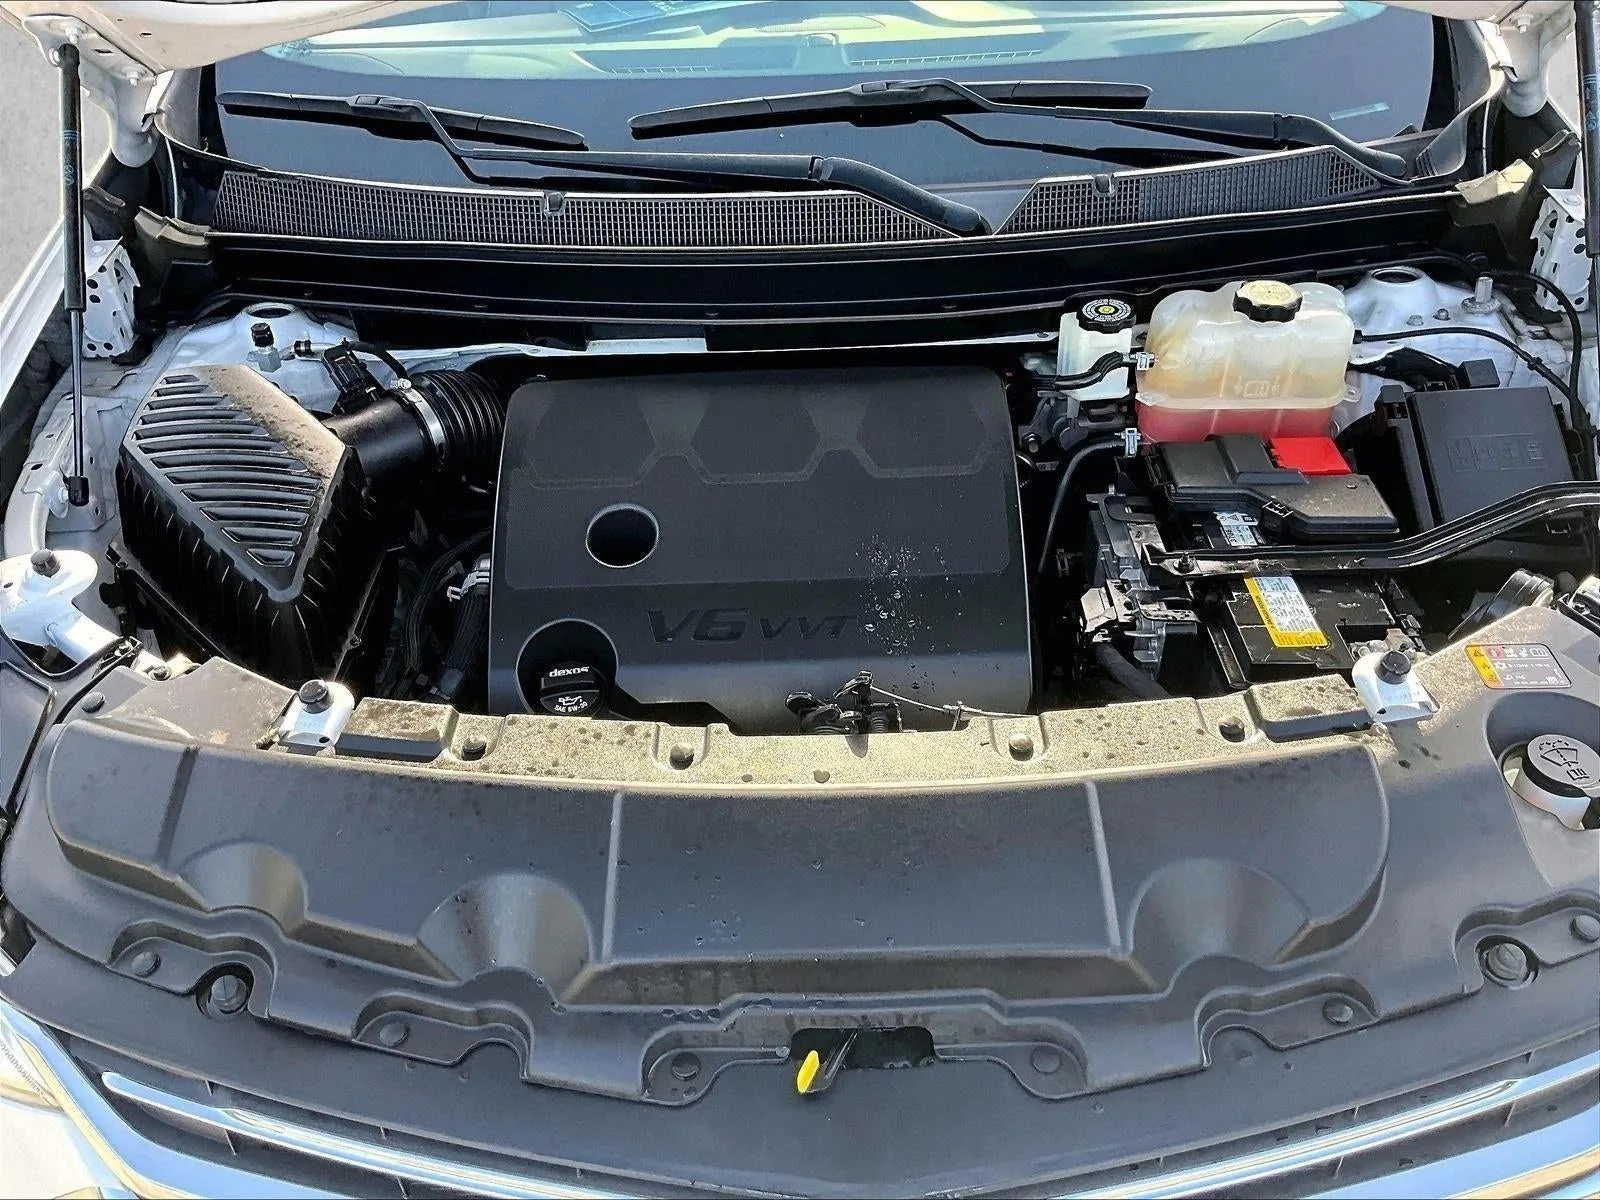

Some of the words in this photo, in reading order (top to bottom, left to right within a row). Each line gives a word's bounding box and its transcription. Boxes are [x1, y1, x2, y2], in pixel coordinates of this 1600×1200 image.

[648, 608, 749, 643] V6
[759, 615, 857, 641] VVT
[549, 666, 590, 677] dexos
[554, 704, 567, 713] SAE
